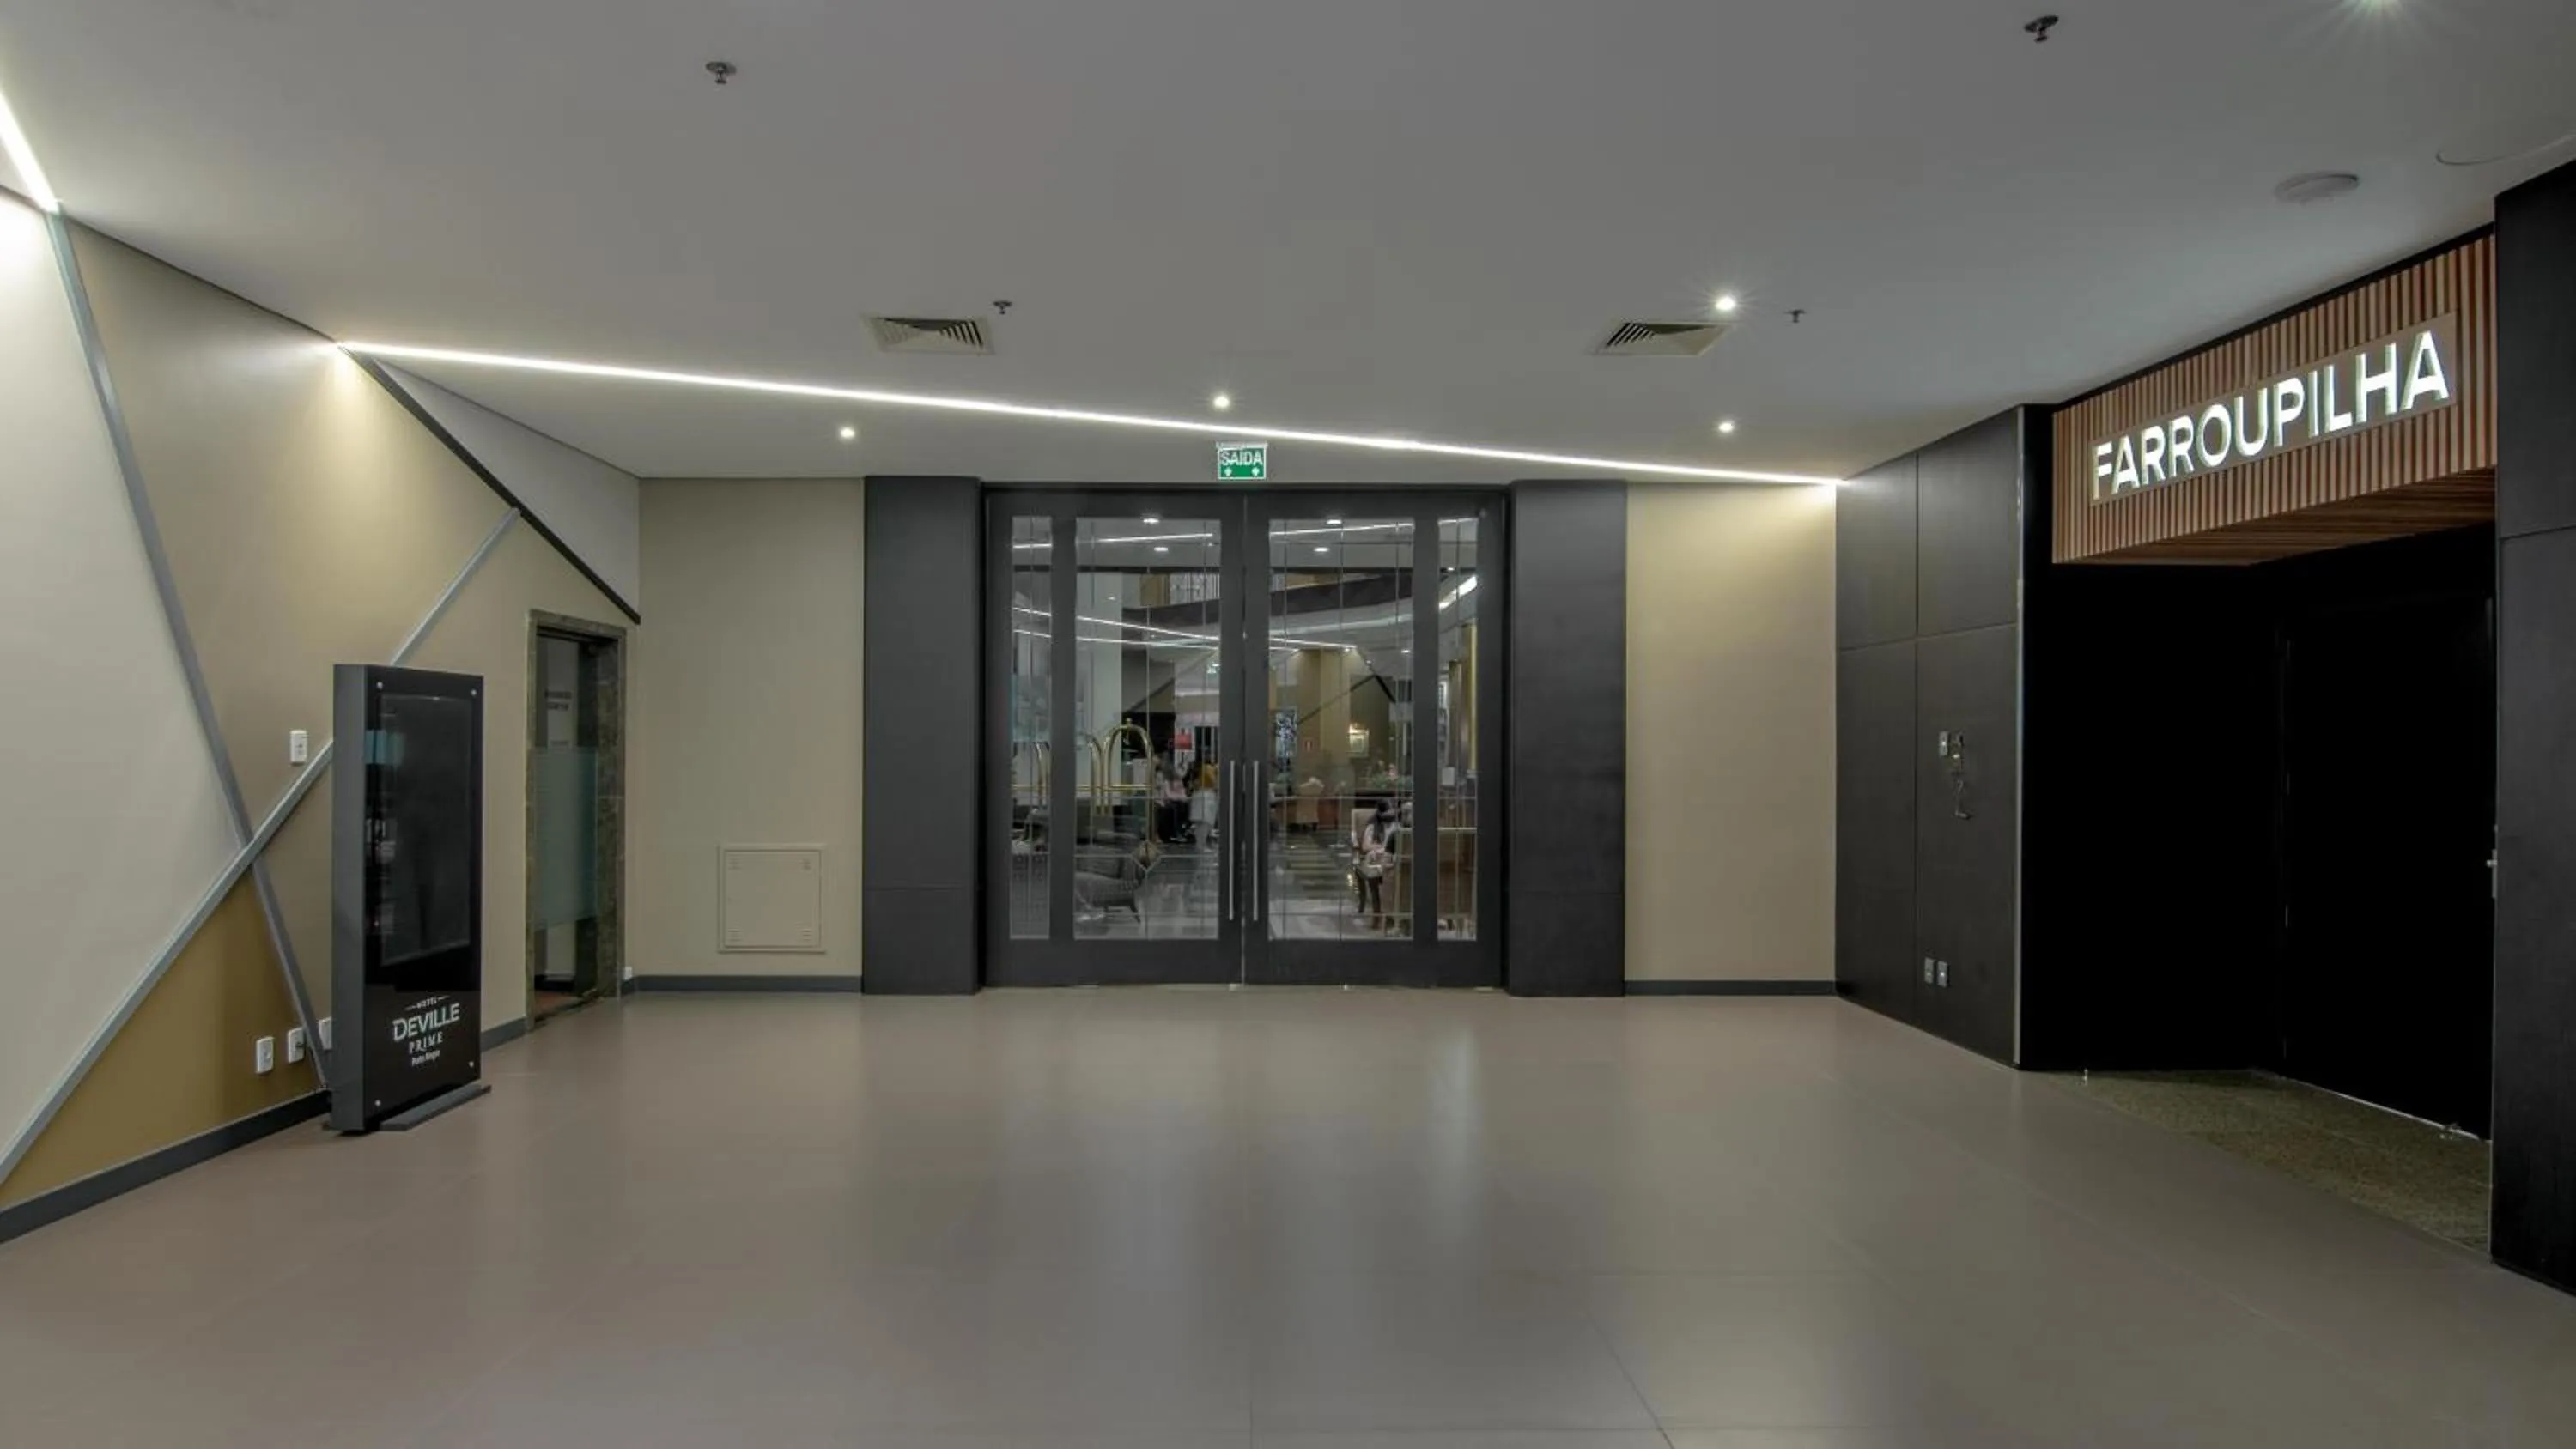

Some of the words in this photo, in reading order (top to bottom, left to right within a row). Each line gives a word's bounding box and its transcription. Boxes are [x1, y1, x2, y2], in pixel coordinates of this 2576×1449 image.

[2093, 330, 2449, 500] FARROUPILHA
[392, 1003, 460, 1042] DEVILLE
[409, 1031, 443, 1054] PRIME
